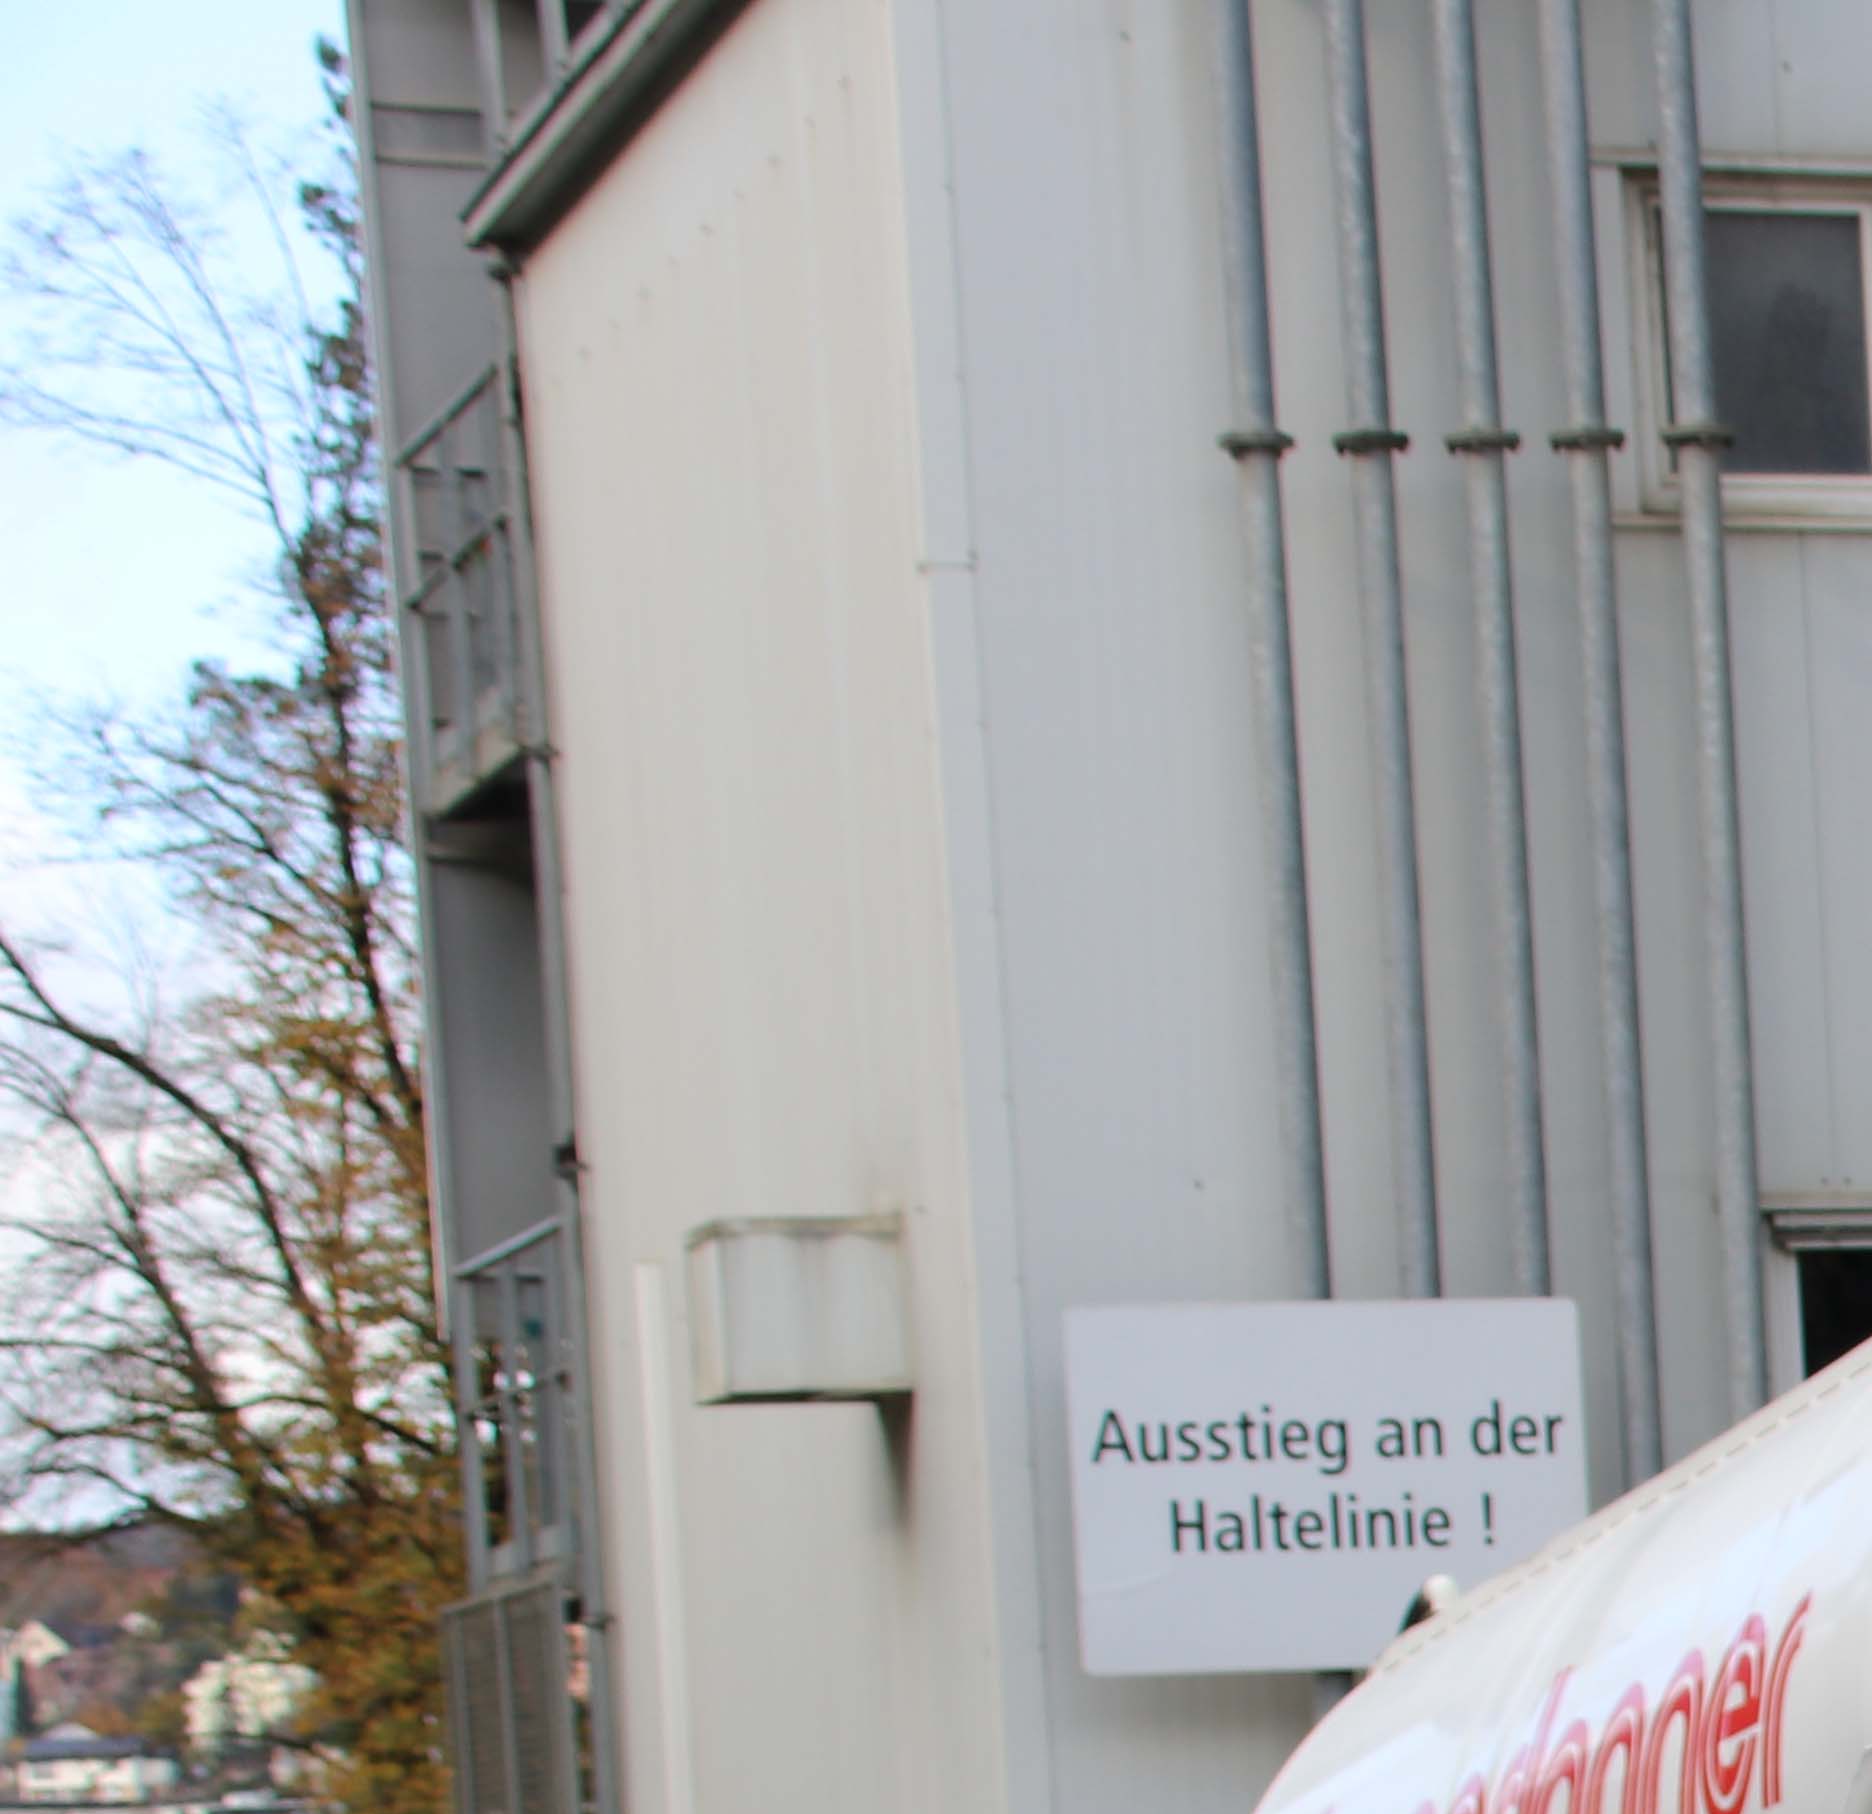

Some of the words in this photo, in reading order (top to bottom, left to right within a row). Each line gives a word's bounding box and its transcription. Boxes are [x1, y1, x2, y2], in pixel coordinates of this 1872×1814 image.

[1091, 1405, 1349, 1476] Ausstieg
[1375, 1415, 1443, 1458] an
[1470, 1398, 1564, 1455] der
[1170, 1493, 1452, 1553] Haltelinie
[1481, 1493, 1495, 1545] !
